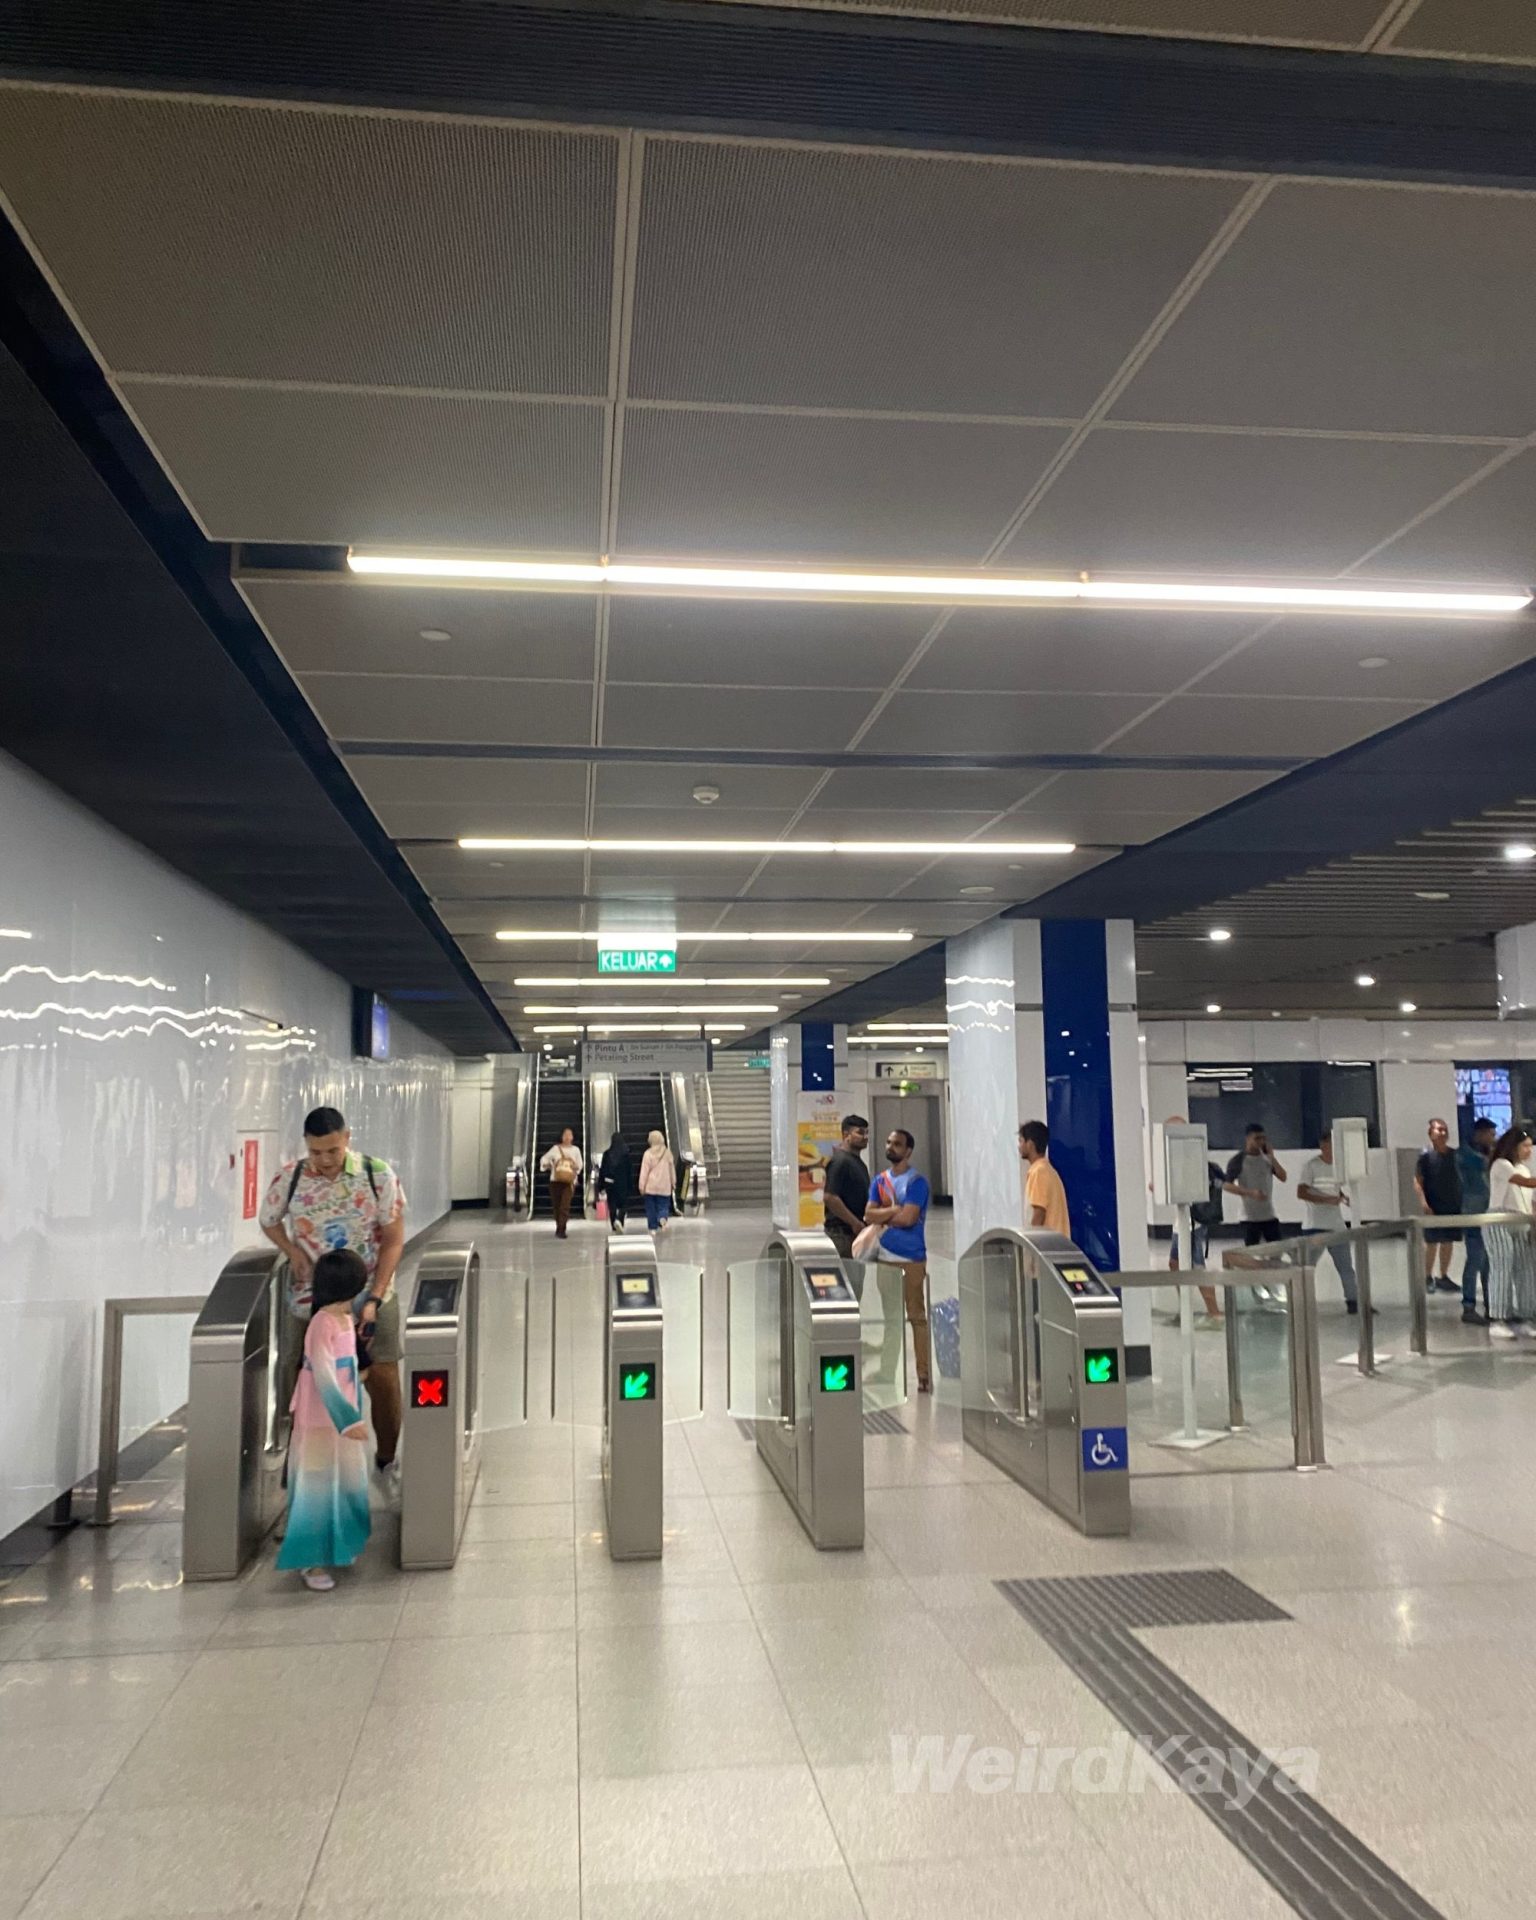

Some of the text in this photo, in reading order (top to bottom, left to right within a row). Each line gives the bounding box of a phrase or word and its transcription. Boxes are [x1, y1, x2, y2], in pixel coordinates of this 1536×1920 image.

[601, 951, 658, 970] KELUAR
[594, 1044, 617, 1052] Pintu
[618, 1043, 625, 1052] A
[594, 1053, 654, 1063] Petaling Street
